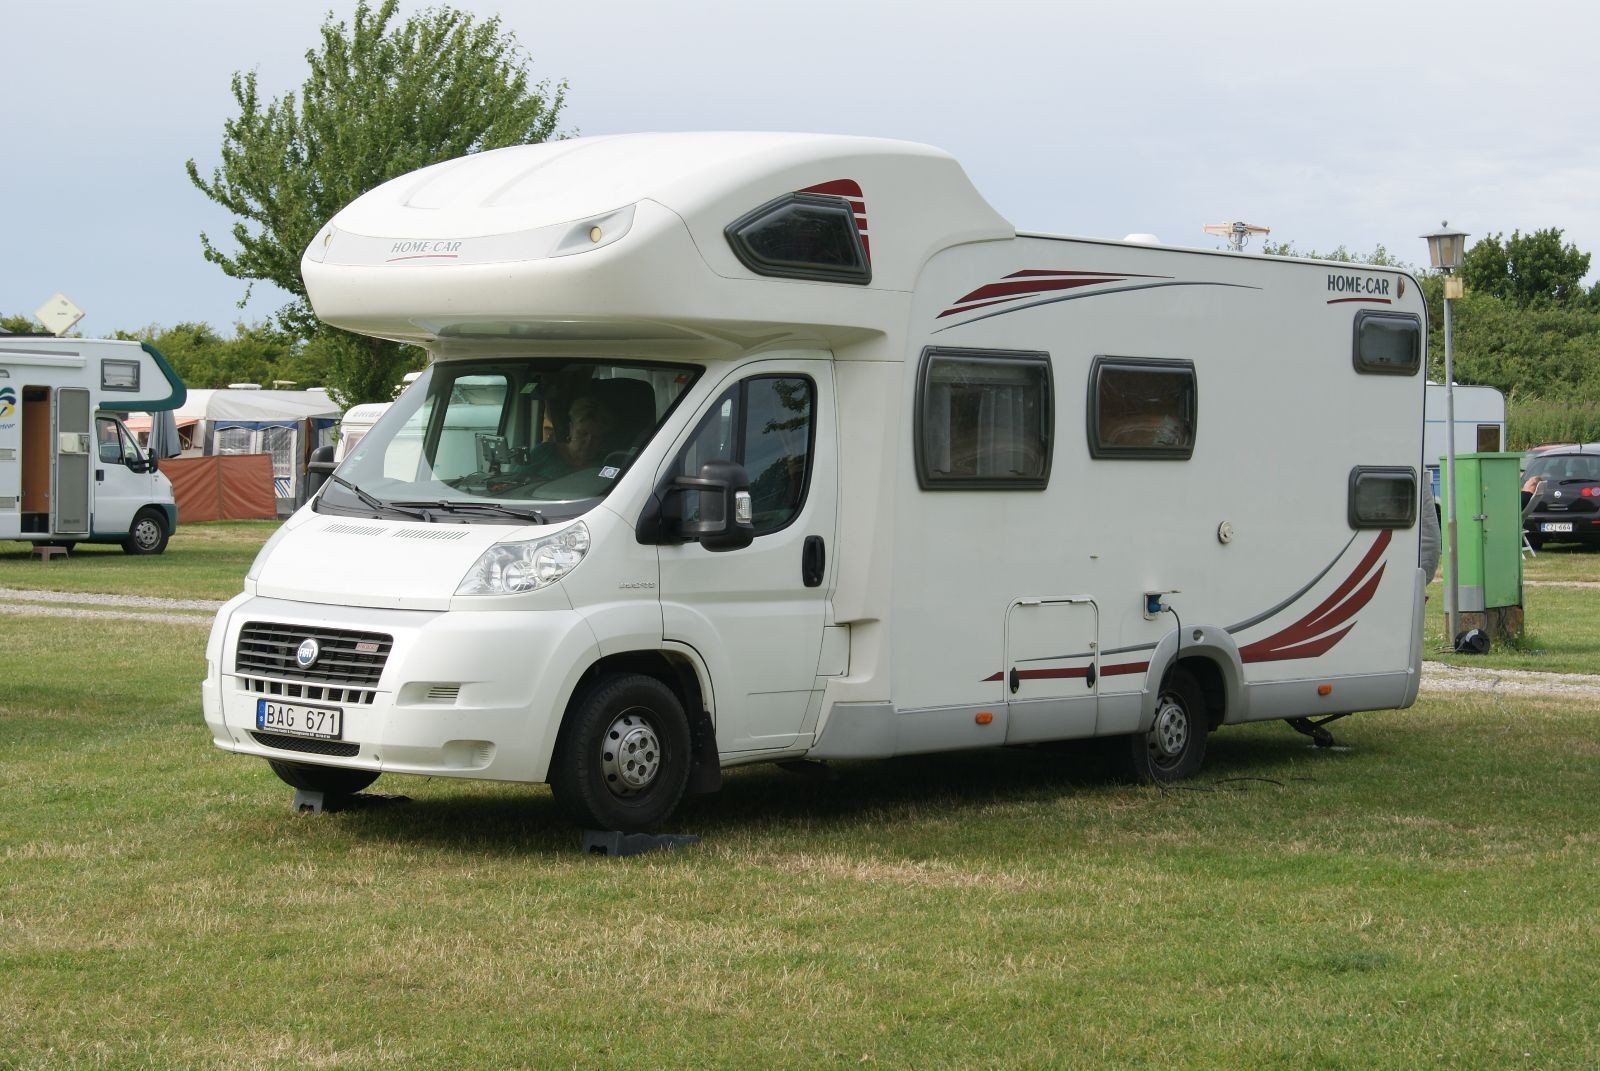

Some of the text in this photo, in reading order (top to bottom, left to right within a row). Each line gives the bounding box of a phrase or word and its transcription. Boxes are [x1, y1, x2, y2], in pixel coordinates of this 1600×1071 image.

[391, 241, 462, 253] HOME-CAR
[1327, 274, 1390, 295] HOME-CAR
[300, 647, 314, 658] FIAT
[266, 704, 295, 727] BAG
[306, 710, 335, 734] 671
